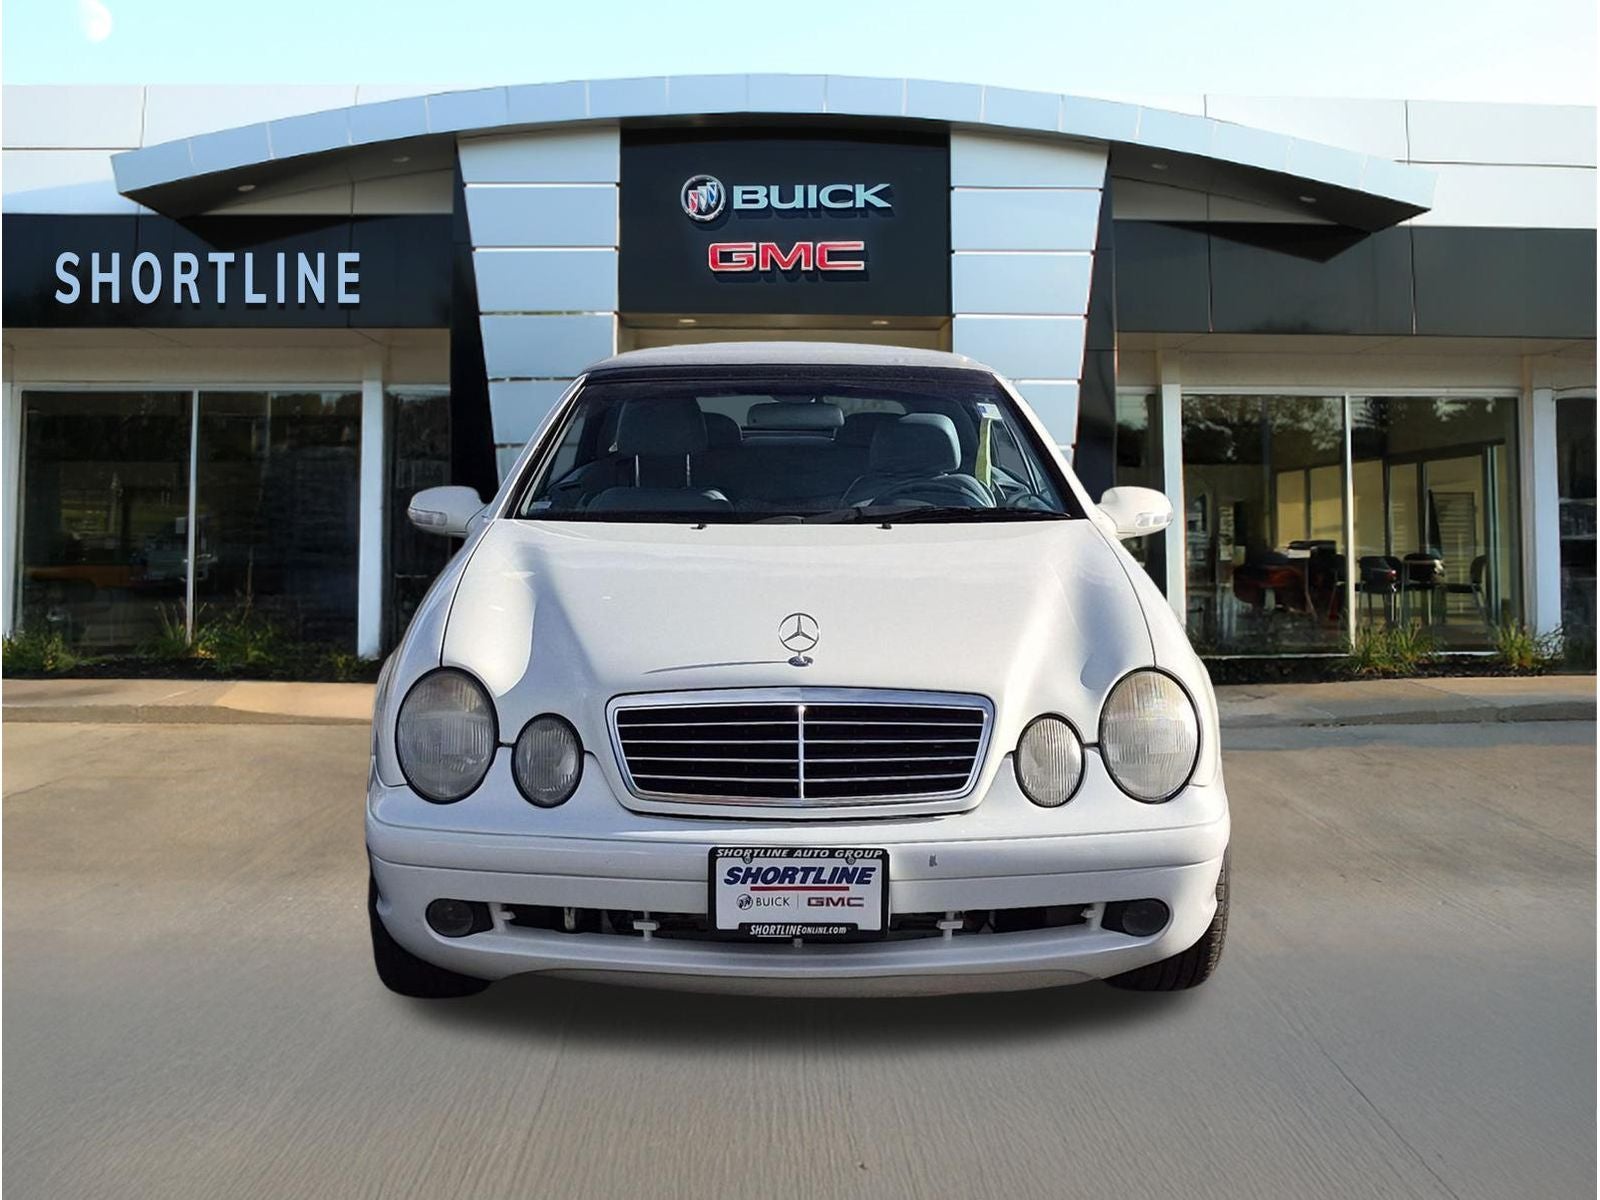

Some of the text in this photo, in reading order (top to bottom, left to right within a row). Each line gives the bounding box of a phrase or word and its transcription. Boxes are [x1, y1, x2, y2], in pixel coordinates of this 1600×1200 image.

[733, 183, 892, 210] BUICK
[708, 241, 865, 272] GMC
[55, 251, 360, 304] SHORTLINE
[716, 849, 883, 858] SHORTLINE AUTO GROUP
[723, 867, 876, 885] SHORTLINE
[756, 897, 864, 907] BUICK GMC
